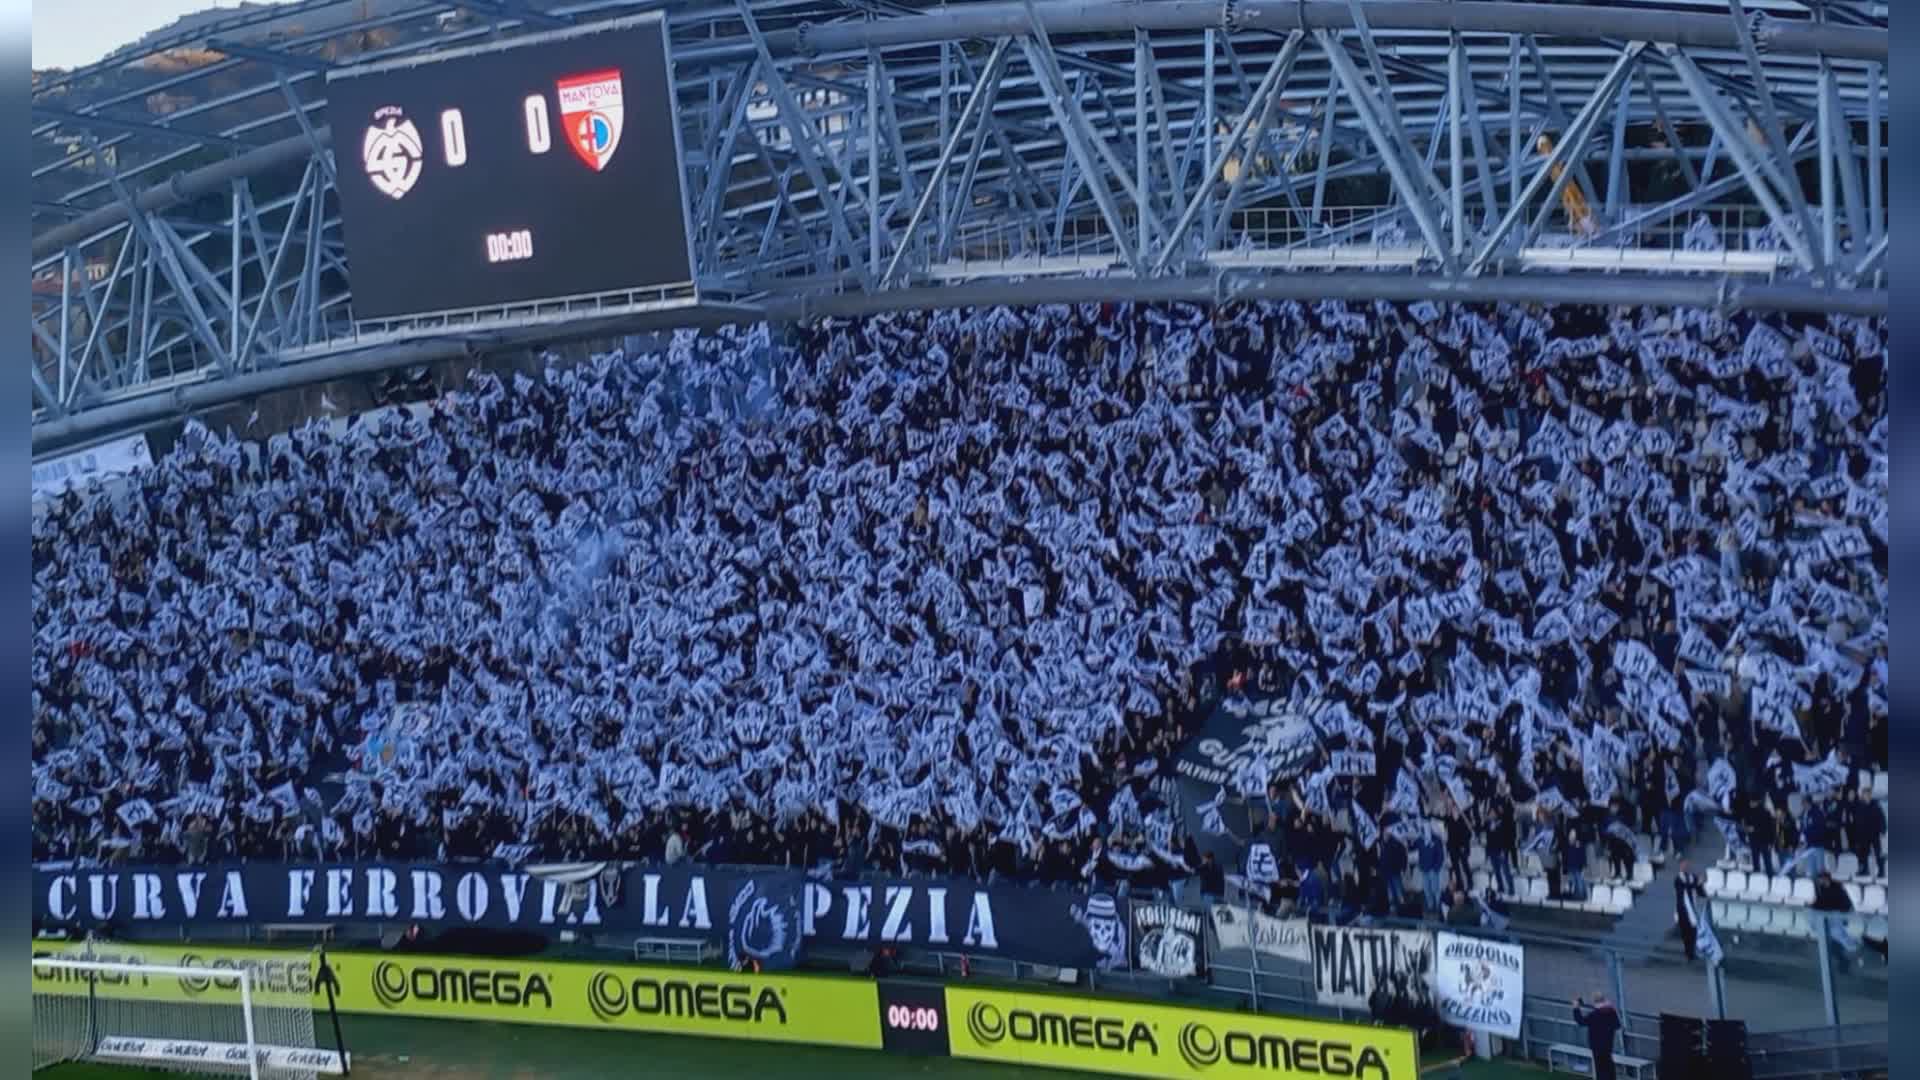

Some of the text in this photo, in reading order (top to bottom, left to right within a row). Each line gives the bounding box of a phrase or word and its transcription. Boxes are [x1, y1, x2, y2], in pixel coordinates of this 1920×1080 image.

[562, 83, 619, 104] MANTOVA
[441, 95, 551, 167] 0 0
[487, 230, 533, 262] 00:00
[48, 869, 249, 920] CURVA
[643, 873, 713, 930] LA
[802, 881, 999, 949] PEZIA
[411, 966, 553, 1009] OMEGA
[631, 978, 787, 1025] OMEGA
[888, 1004, 939, 1032] 00:00
[1008, 1009, 1160, 1056] OMEGA
[1224, 1030, 1391, 1080] OMEGA
